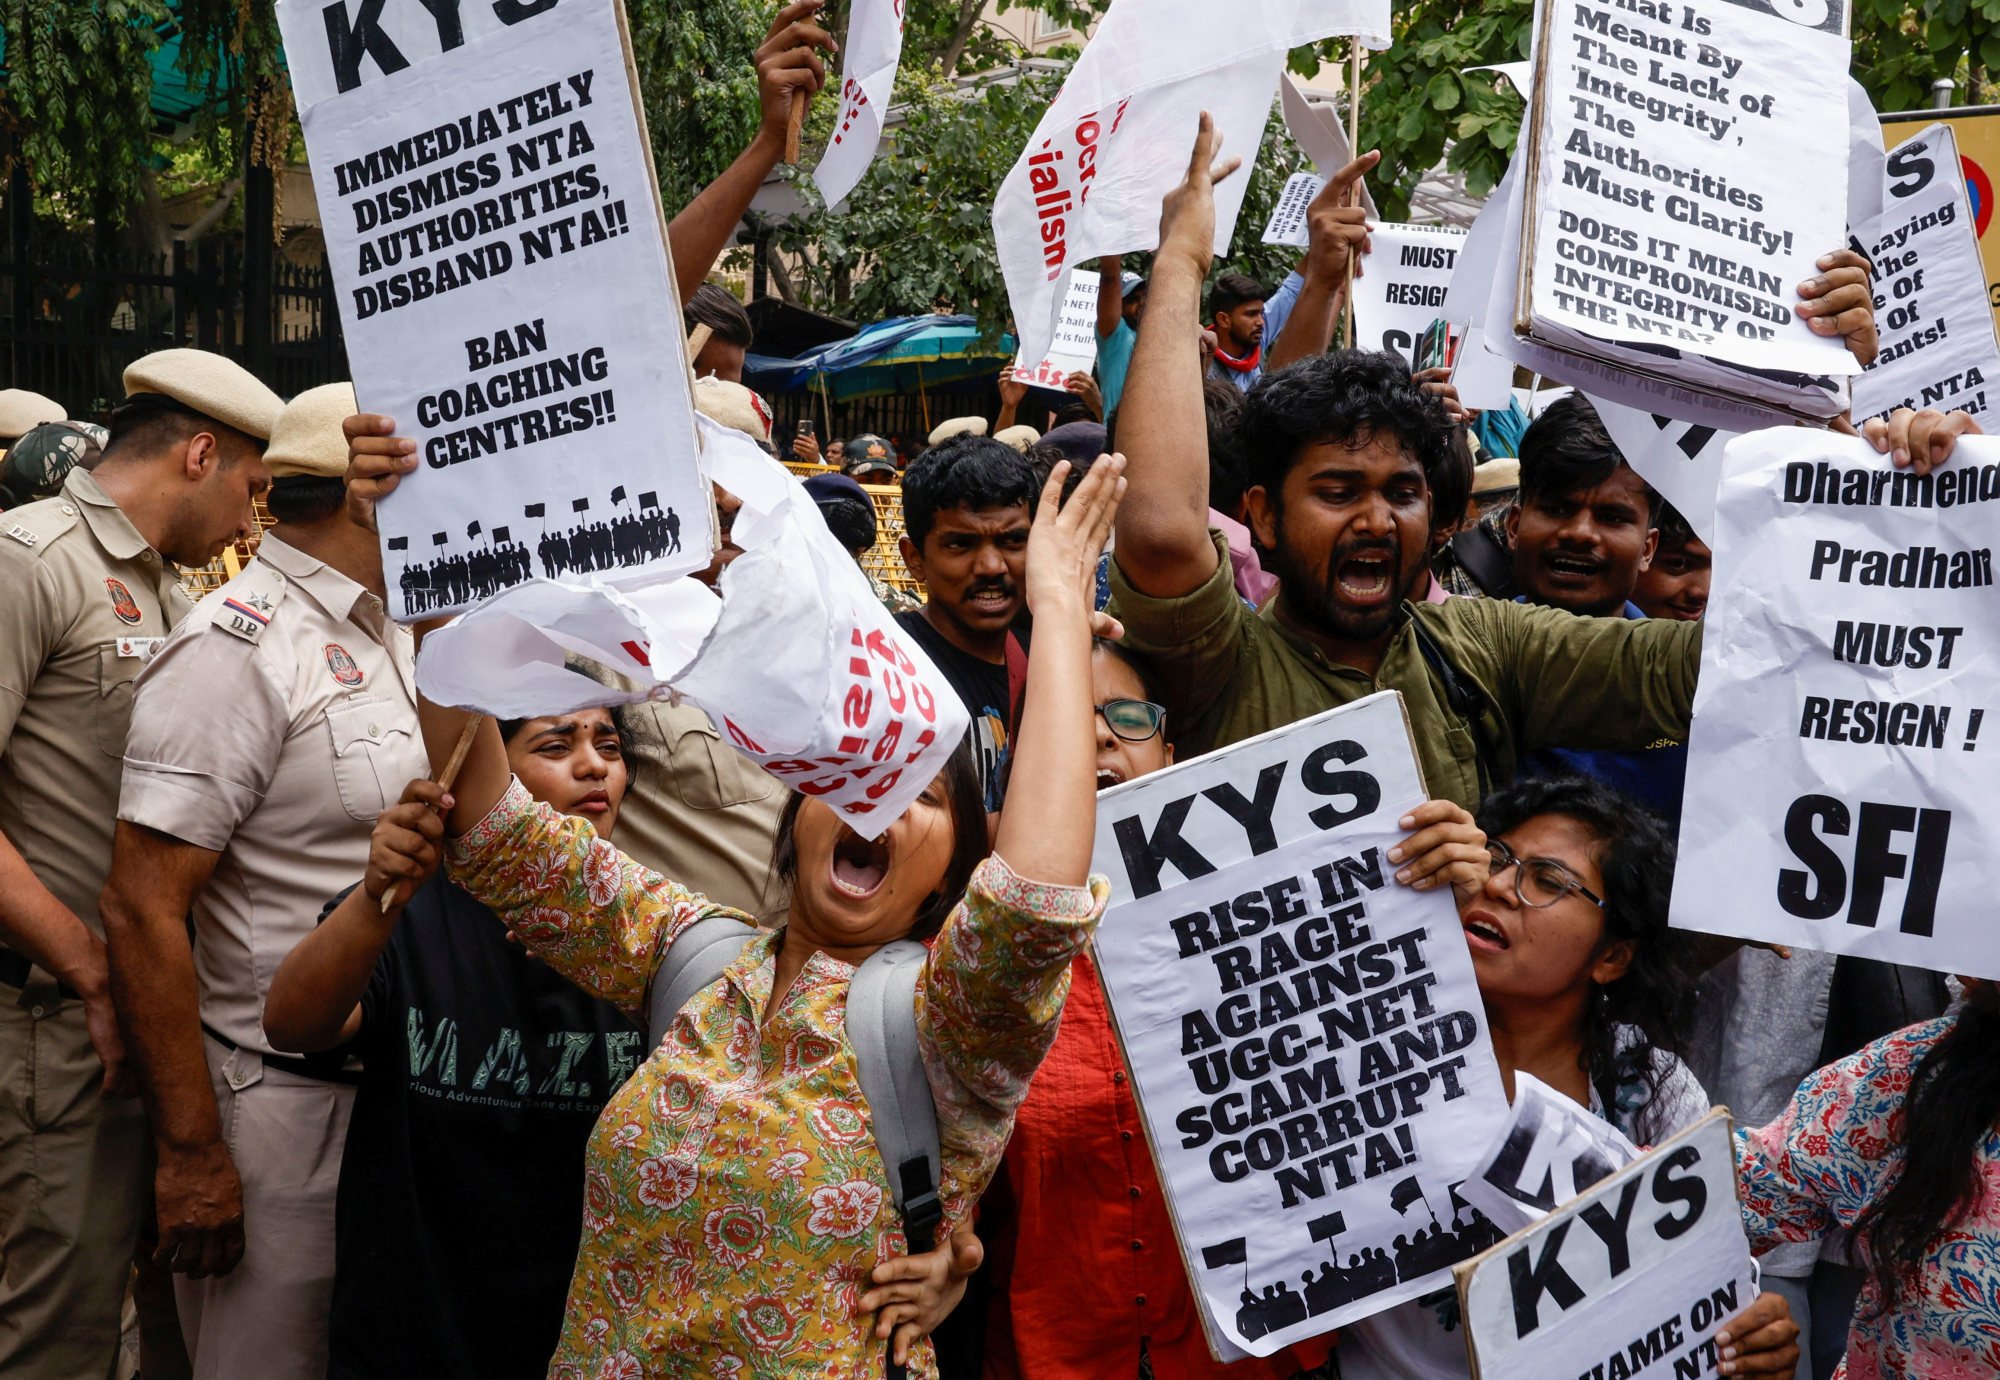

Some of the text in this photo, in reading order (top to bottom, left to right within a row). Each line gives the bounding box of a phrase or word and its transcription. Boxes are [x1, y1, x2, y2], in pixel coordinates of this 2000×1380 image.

[1574, 3, 1743, 79] Meant By
[1681, 5, 1711, 36] Is
[1572, 33, 1776, 119] The Lack of
[334, 69, 594, 196] IMMEDIATELY
[1569, 95, 1636, 139] The
[352, 120, 595, 233] DISMISS NTA
[1277, 176, 1312, 239] PUTS OUR FUTURE
[1281, 181, 1299, 210] FAILURE
[1562, 159, 1794, 256] Must Clarify!
[1564, 127, 1764, 212] Authorities
[352, 200, 630, 320] DISBAND NTA!!
[358, 164, 609, 276] AUTHORITIES,
[1289, 224, 1298, 233] IN
[1400, 245, 1458, 270] MUST
[1558, 209, 1782, 297] DOES IT MEAN
[1070, 300, 1095, 312] NET!
[1553, 290, 1618, 325] THE
[1554, 263, 1775, 342] INTEGRITY OF
[1556, 238, 1791, 325] COMPROMISED
[1887, 300, 1920, 330] Of
[1893, 269, 1924, 299] Of
[464, 318, 547, 371] BAN
[1066, 317, 1085, 328] hall
[417, 347, 608, 428] COACHING
[1920, 367, 1985, 407] NTA
[425, 390, 617, 469] CENTRES!!
[1810, 540, 1993, 590] Pradhan
[1833, 621, 1963, 670] MUST
[1800, 696, 1984, 752] RESIGN !
[1112, 739, 1382, 900] KYS
[1169, 847, 1386, 959] RISE IN
[1777, 794, 1952, 938] SFI
[1213, 902, 1373, 994] RAGE
[1180, 927, 1428, 1056] AGAINST
[1187, 972, 1437, 1095] UGC-NET
[1175, 1010, 1478, 1150] SCAM AND
[1208, 1055, 1466, 1183] CORRUPT
[1274, 1123, 1418, 1209] NTA!
[1507, 1146, 1708, 1340] KYS
[1690, 1279, 1739, 1333] ON
